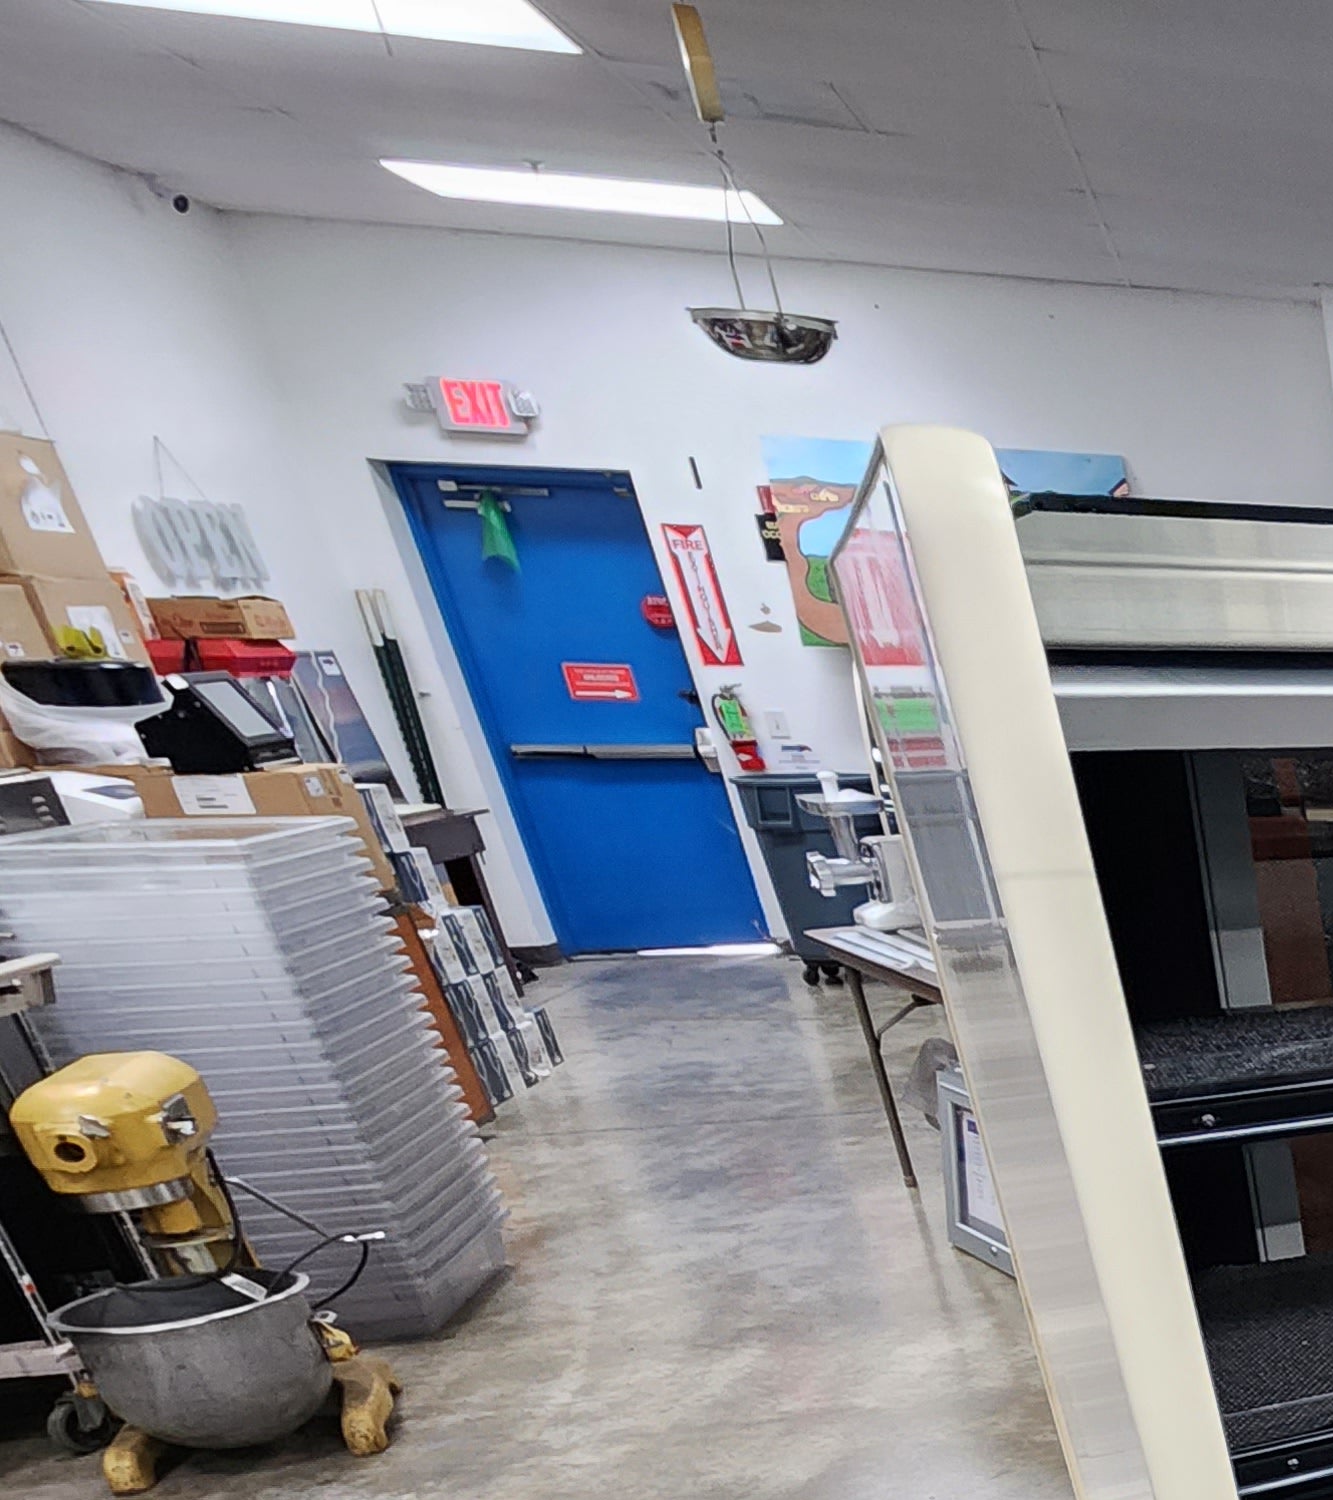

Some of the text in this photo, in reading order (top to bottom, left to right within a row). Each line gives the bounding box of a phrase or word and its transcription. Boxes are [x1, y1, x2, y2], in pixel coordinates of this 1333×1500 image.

[442, 380, 510, 427] EXIT
[131, 495, 269, 584] OPEN
[671, 539, 704, 550] FIRE
